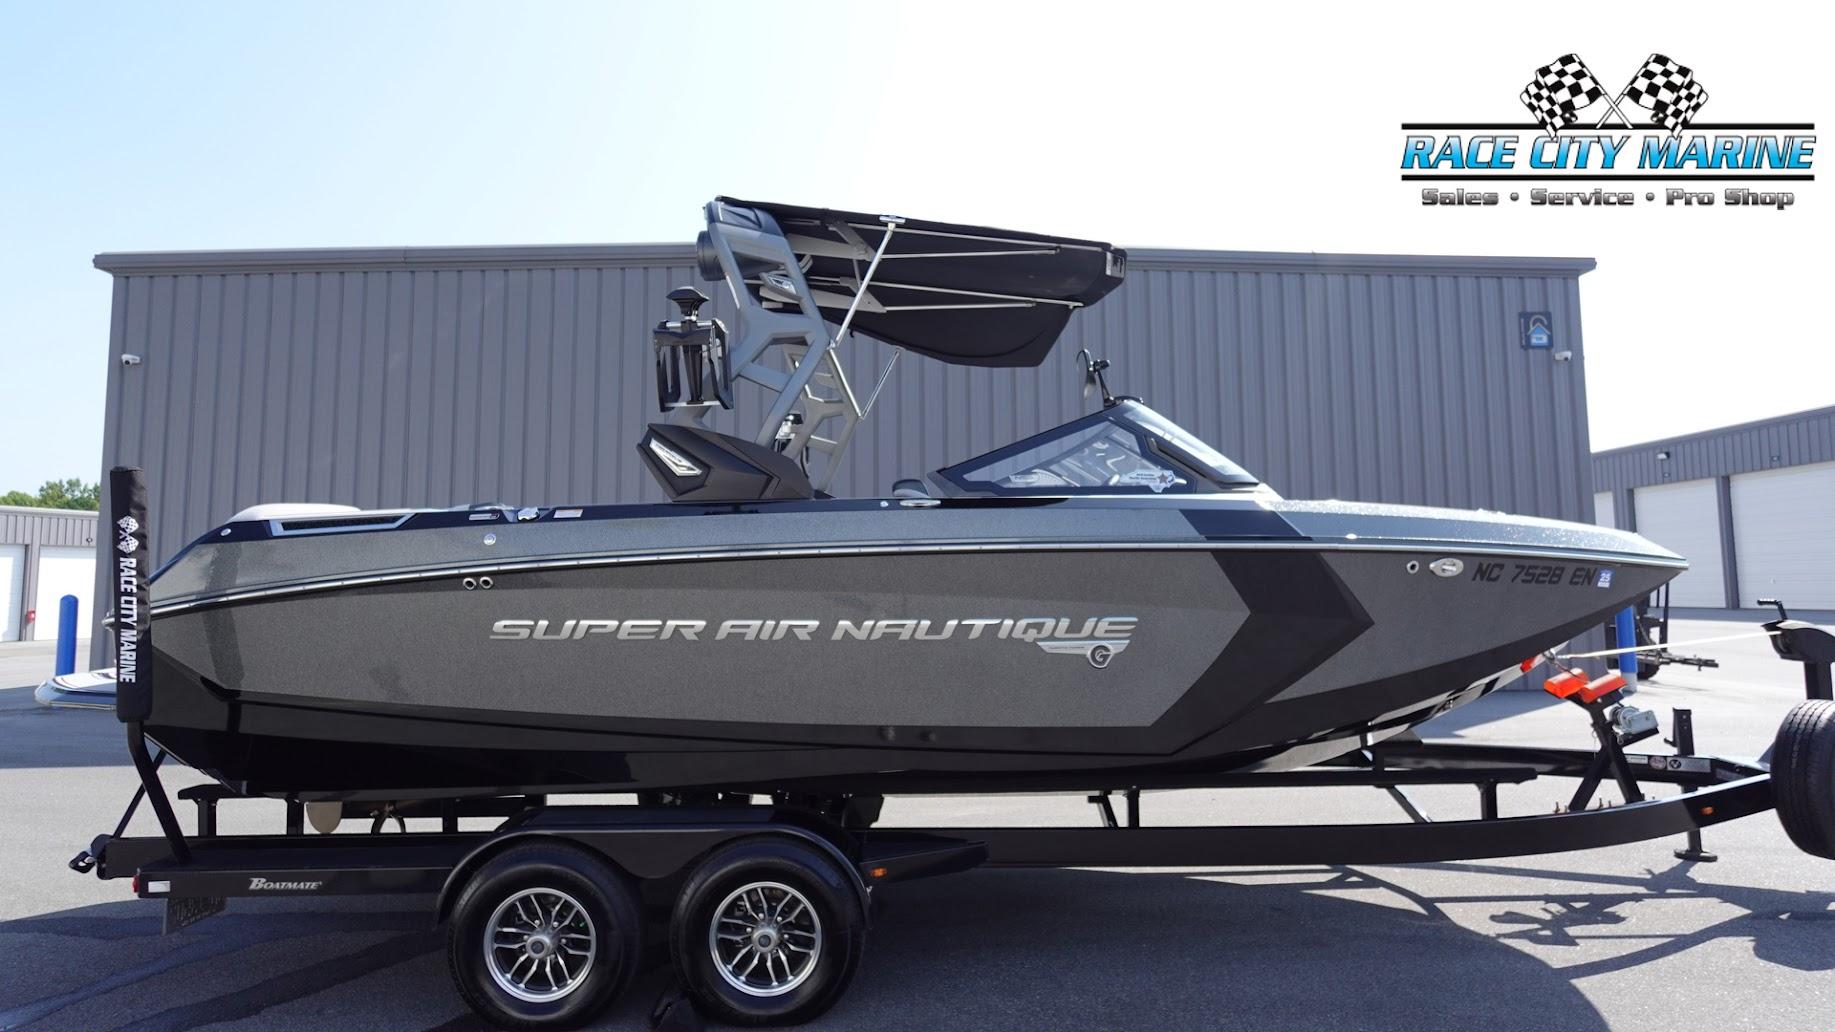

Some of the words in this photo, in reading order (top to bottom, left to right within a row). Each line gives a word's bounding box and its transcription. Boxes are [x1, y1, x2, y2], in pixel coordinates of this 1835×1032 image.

[119, 557, 137, 593] RACE
[1471, 562, 1504, 582] NC
[1511, 564, 1564, 585] 7528
[1568, 567, 1597, 586] EN
[120, 594, 138, 627] CITY
[489, 619, 706, 640] SUPER
[714, 619, 820, 640] AIR
[831, 617, 1138, 642] NAUTIQUE
[119, 628, 137, 683] MARINE
